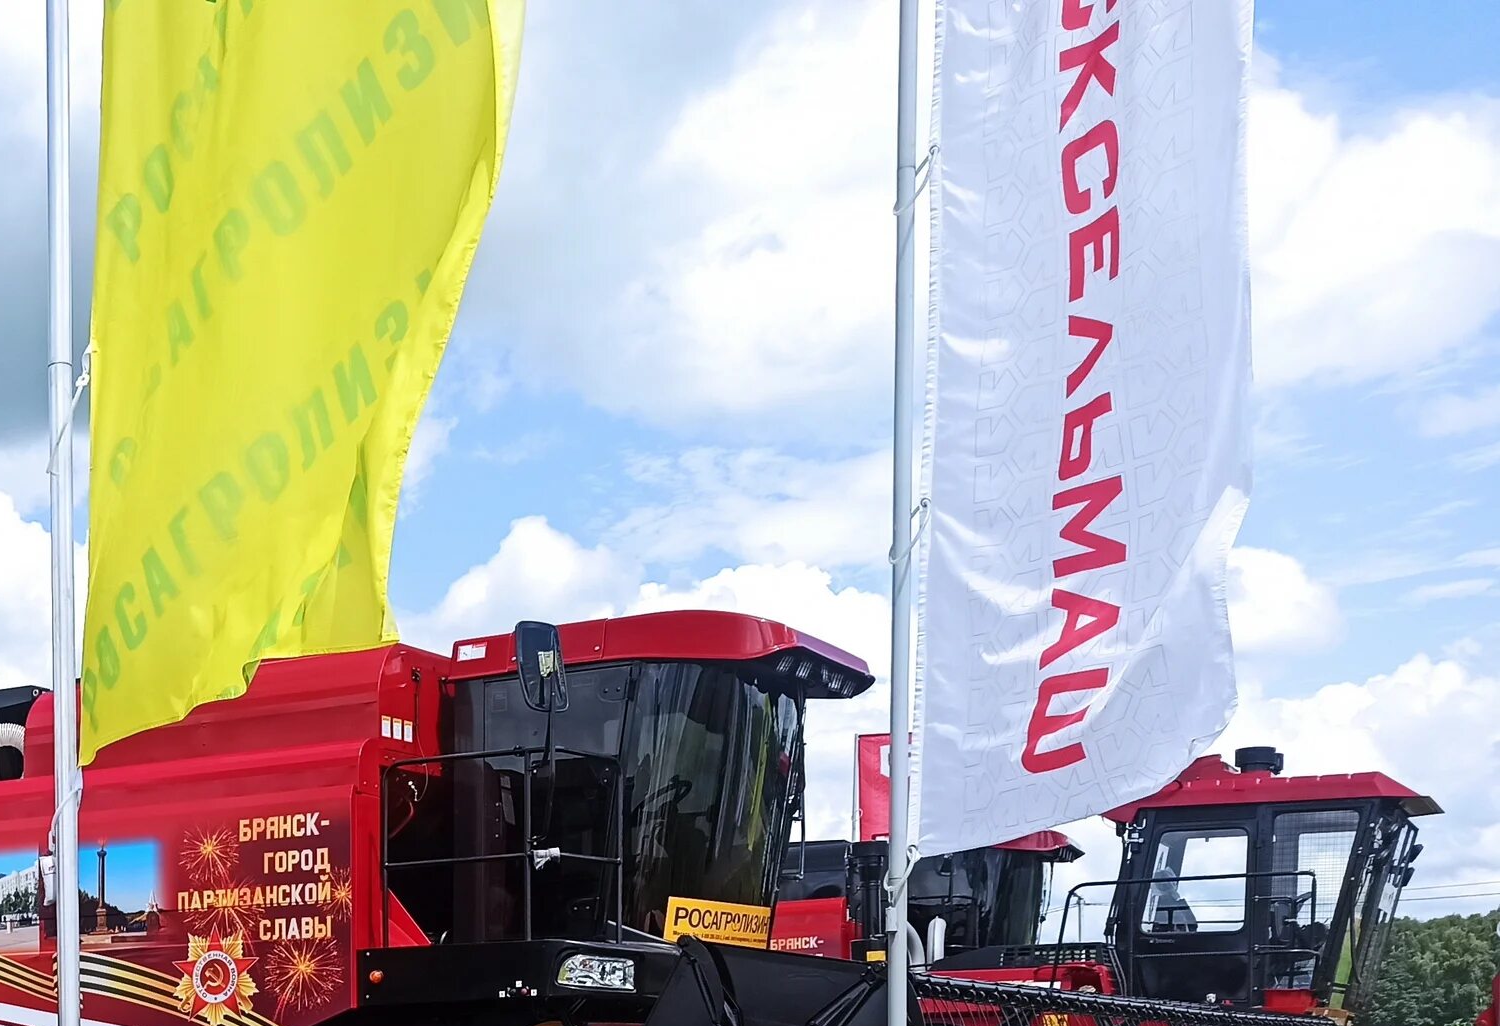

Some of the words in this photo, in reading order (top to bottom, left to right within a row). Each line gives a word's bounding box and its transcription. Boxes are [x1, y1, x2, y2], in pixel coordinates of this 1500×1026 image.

[239, 811, 330, 842] БРЯНСК-
[263, 847, 331, 874] ГОРОД
[177, 874, 331, 912] ПАРТИЗАНСКОЙ
[259, 915, 332, 941] СЛАВЫ
[770, 936, 824, 950] БРЯНСК-
